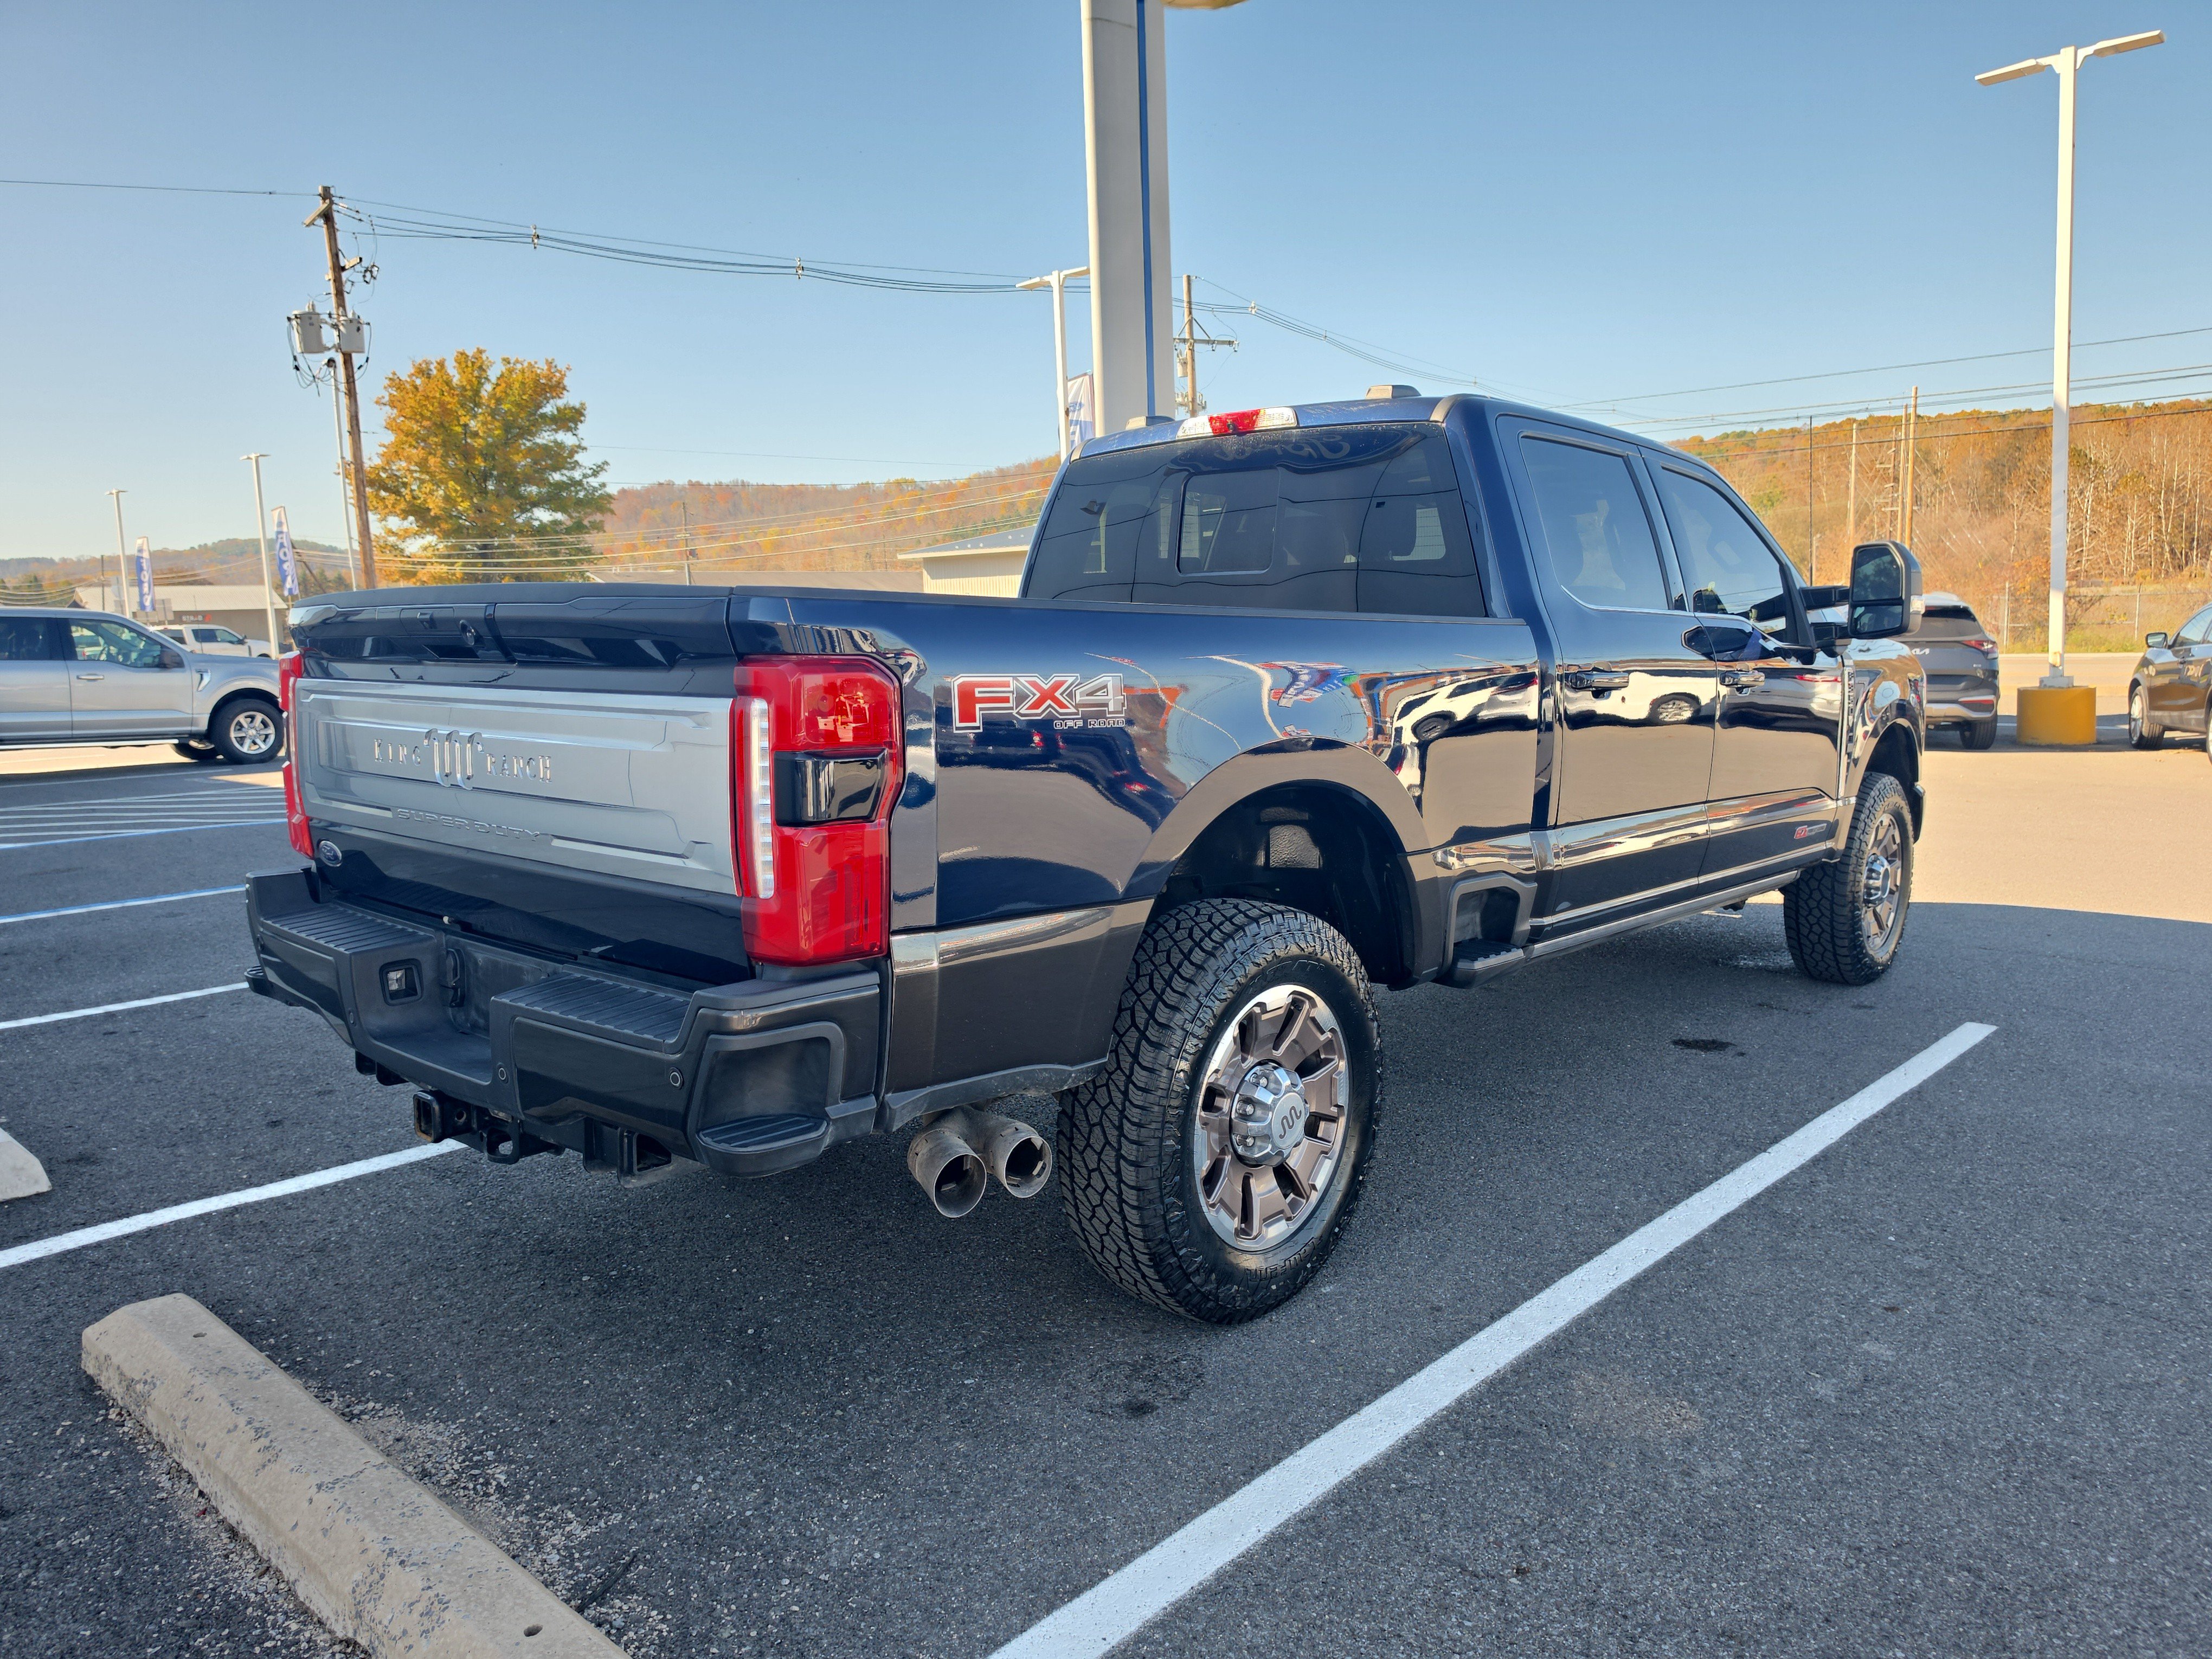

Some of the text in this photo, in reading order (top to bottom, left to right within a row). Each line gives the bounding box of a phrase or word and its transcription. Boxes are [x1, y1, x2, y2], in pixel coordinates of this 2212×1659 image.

[951, 673, 1127, 733] FX4
[1053, 718, 1125, 729] OFF ROAD
[374, 738, 552, 783] KING RANCH
[397, 808, 540, 842] SUPER DUTY
